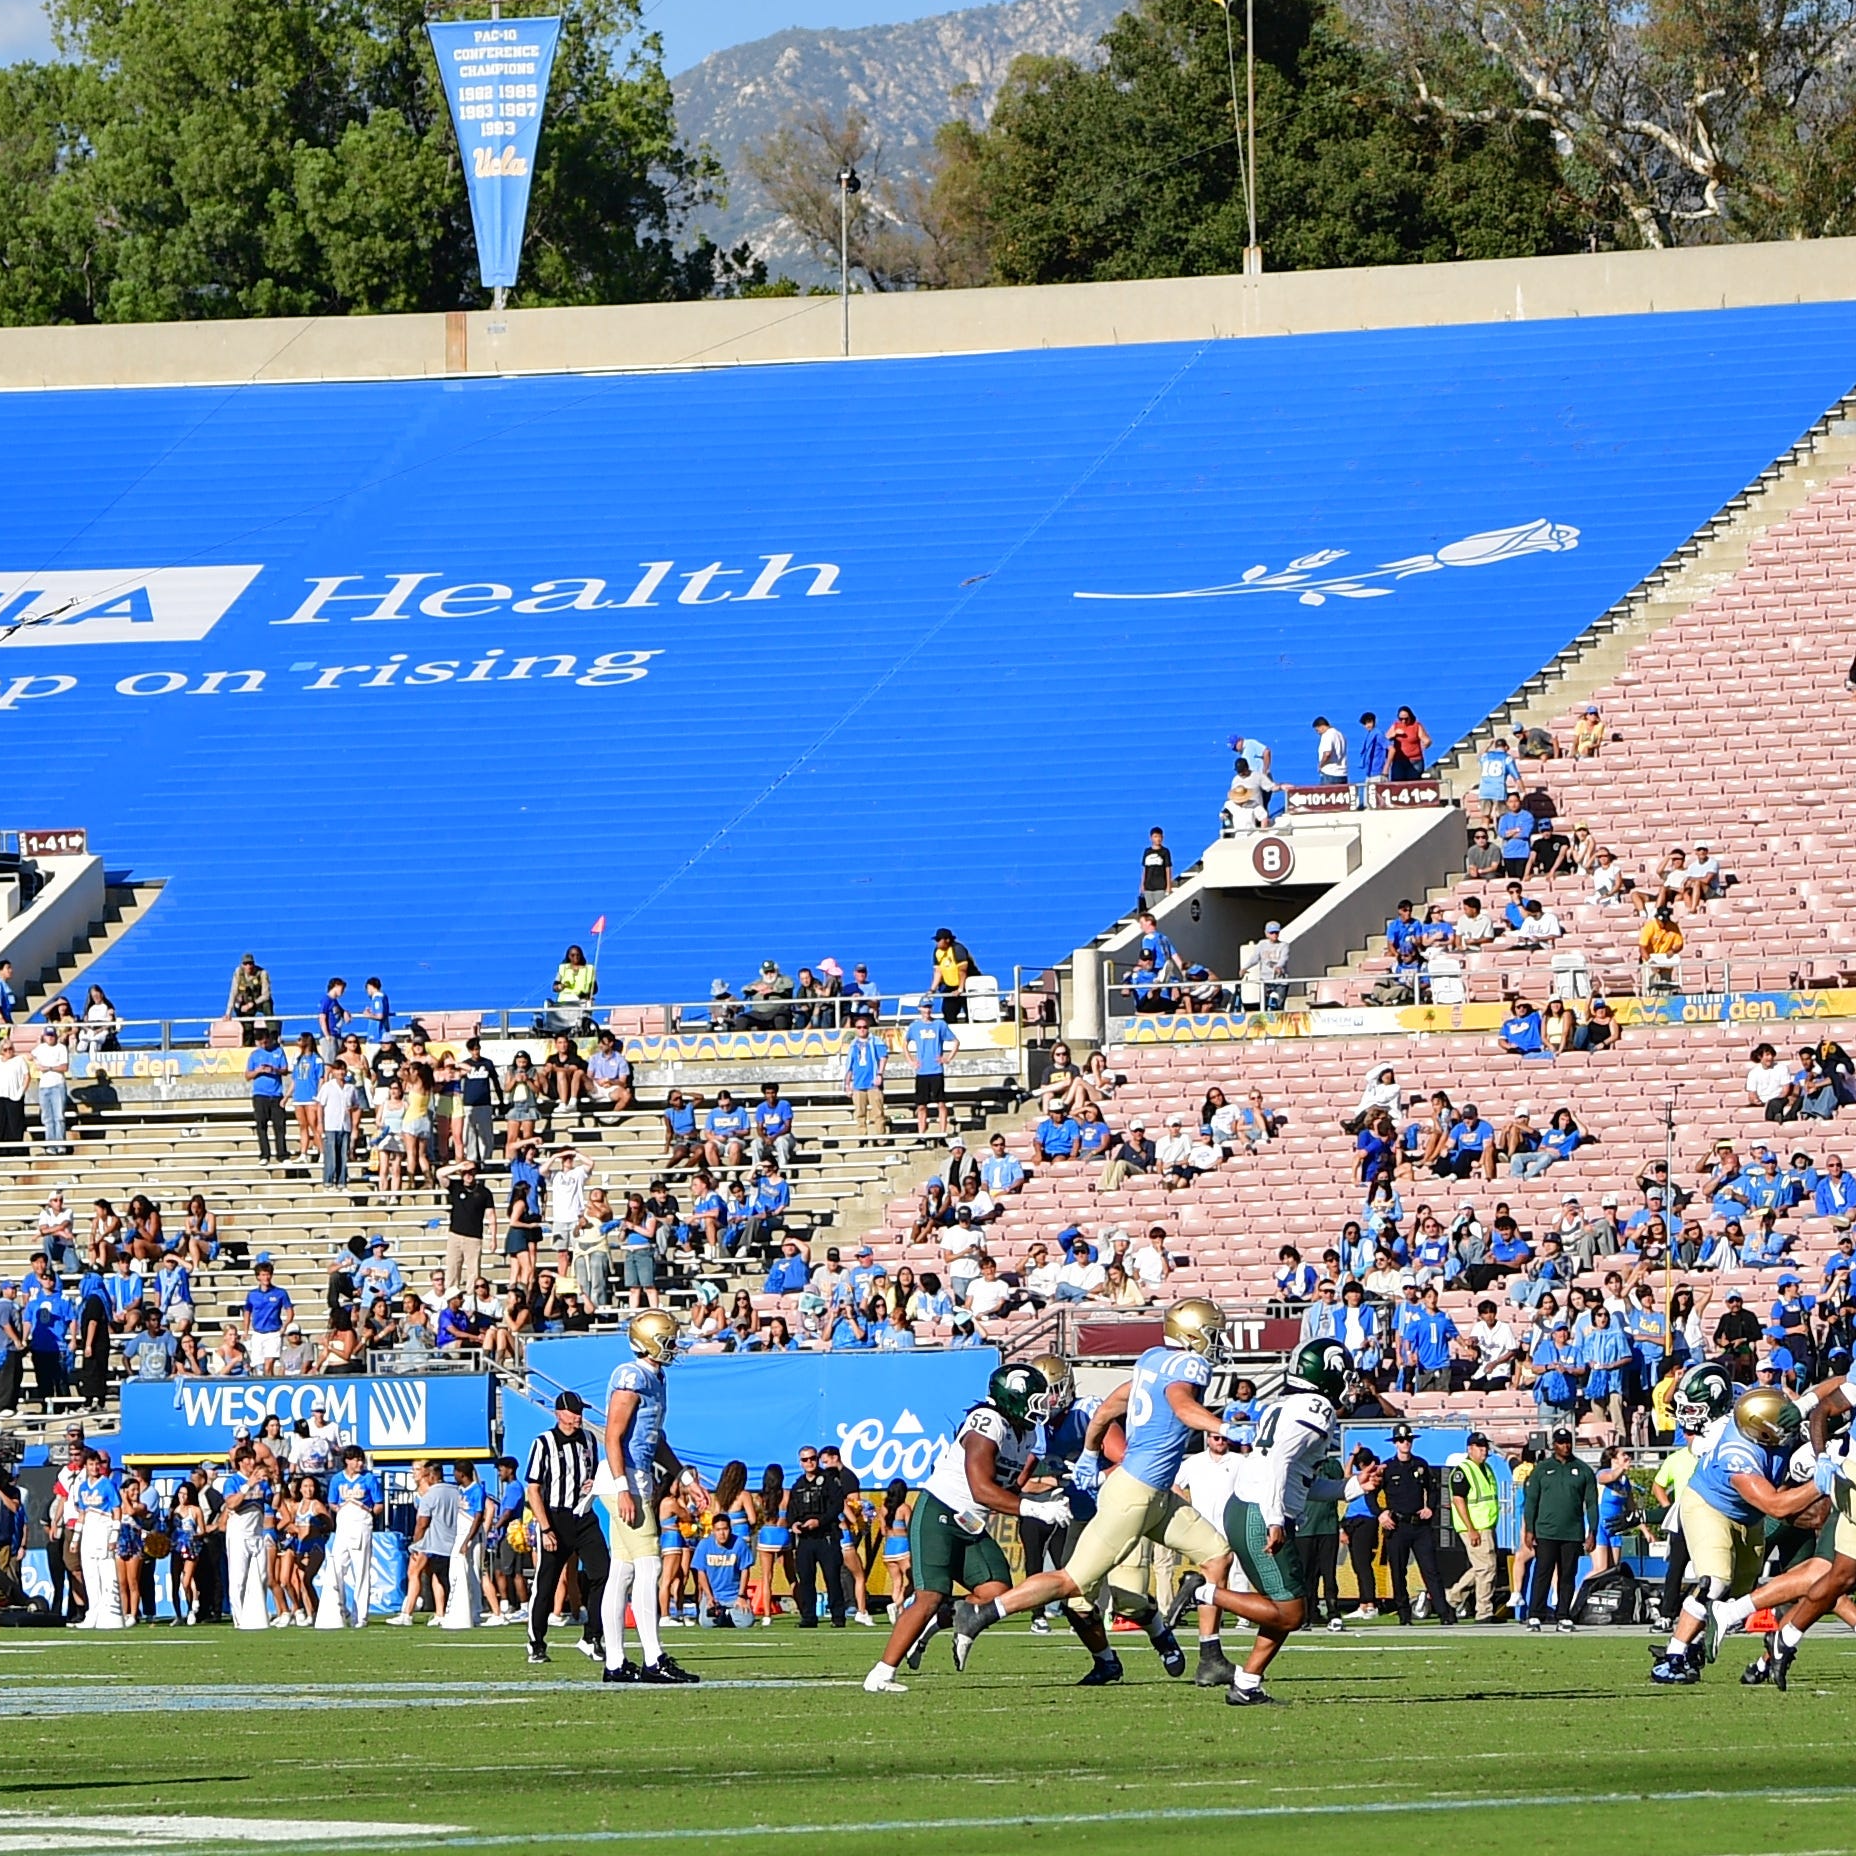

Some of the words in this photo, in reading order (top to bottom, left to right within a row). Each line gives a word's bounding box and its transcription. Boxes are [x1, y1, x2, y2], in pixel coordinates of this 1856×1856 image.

[474, 29, 517, 42] PAC-10
[453, 45, 539, 61] CONFERENCE
[459, 62, 535, 78] CHAMPIONS
[480, 120, 516, 137] 1993
[472, 145, 528, 178] Ucla
[269, 554, 843, 624] Health
[114, 669, 267, 697] on
[301, 648, 665, 689] rising
[1382, 788, 1422, 804] 1-41
[29, 835, 65, 851] 1-41
[1263, 846, 1280, 872] 8
[1682, 1003, 1723, 1022] our
[1728, 999, 1776, 1021] den
[1762, 1190, 1775, 1207] 7
[1221, 1321, 1266, 1351] XIT
[1430, 1322, 1437, 1344] 1
[619, 1368, 638, 1388] 14
[1186, 1358, 1209, 1382] 85
[185, 1384, 357, 1427] WESCOM
[1126, 1366, 1157, 1427] 5
[1309, 1396, 1333, 1422] 34
[969, 1413, 991, 1433] 52
[836, 1419, 951, 1480] Coo
[706, 1553, 736, 1566] UCLA
